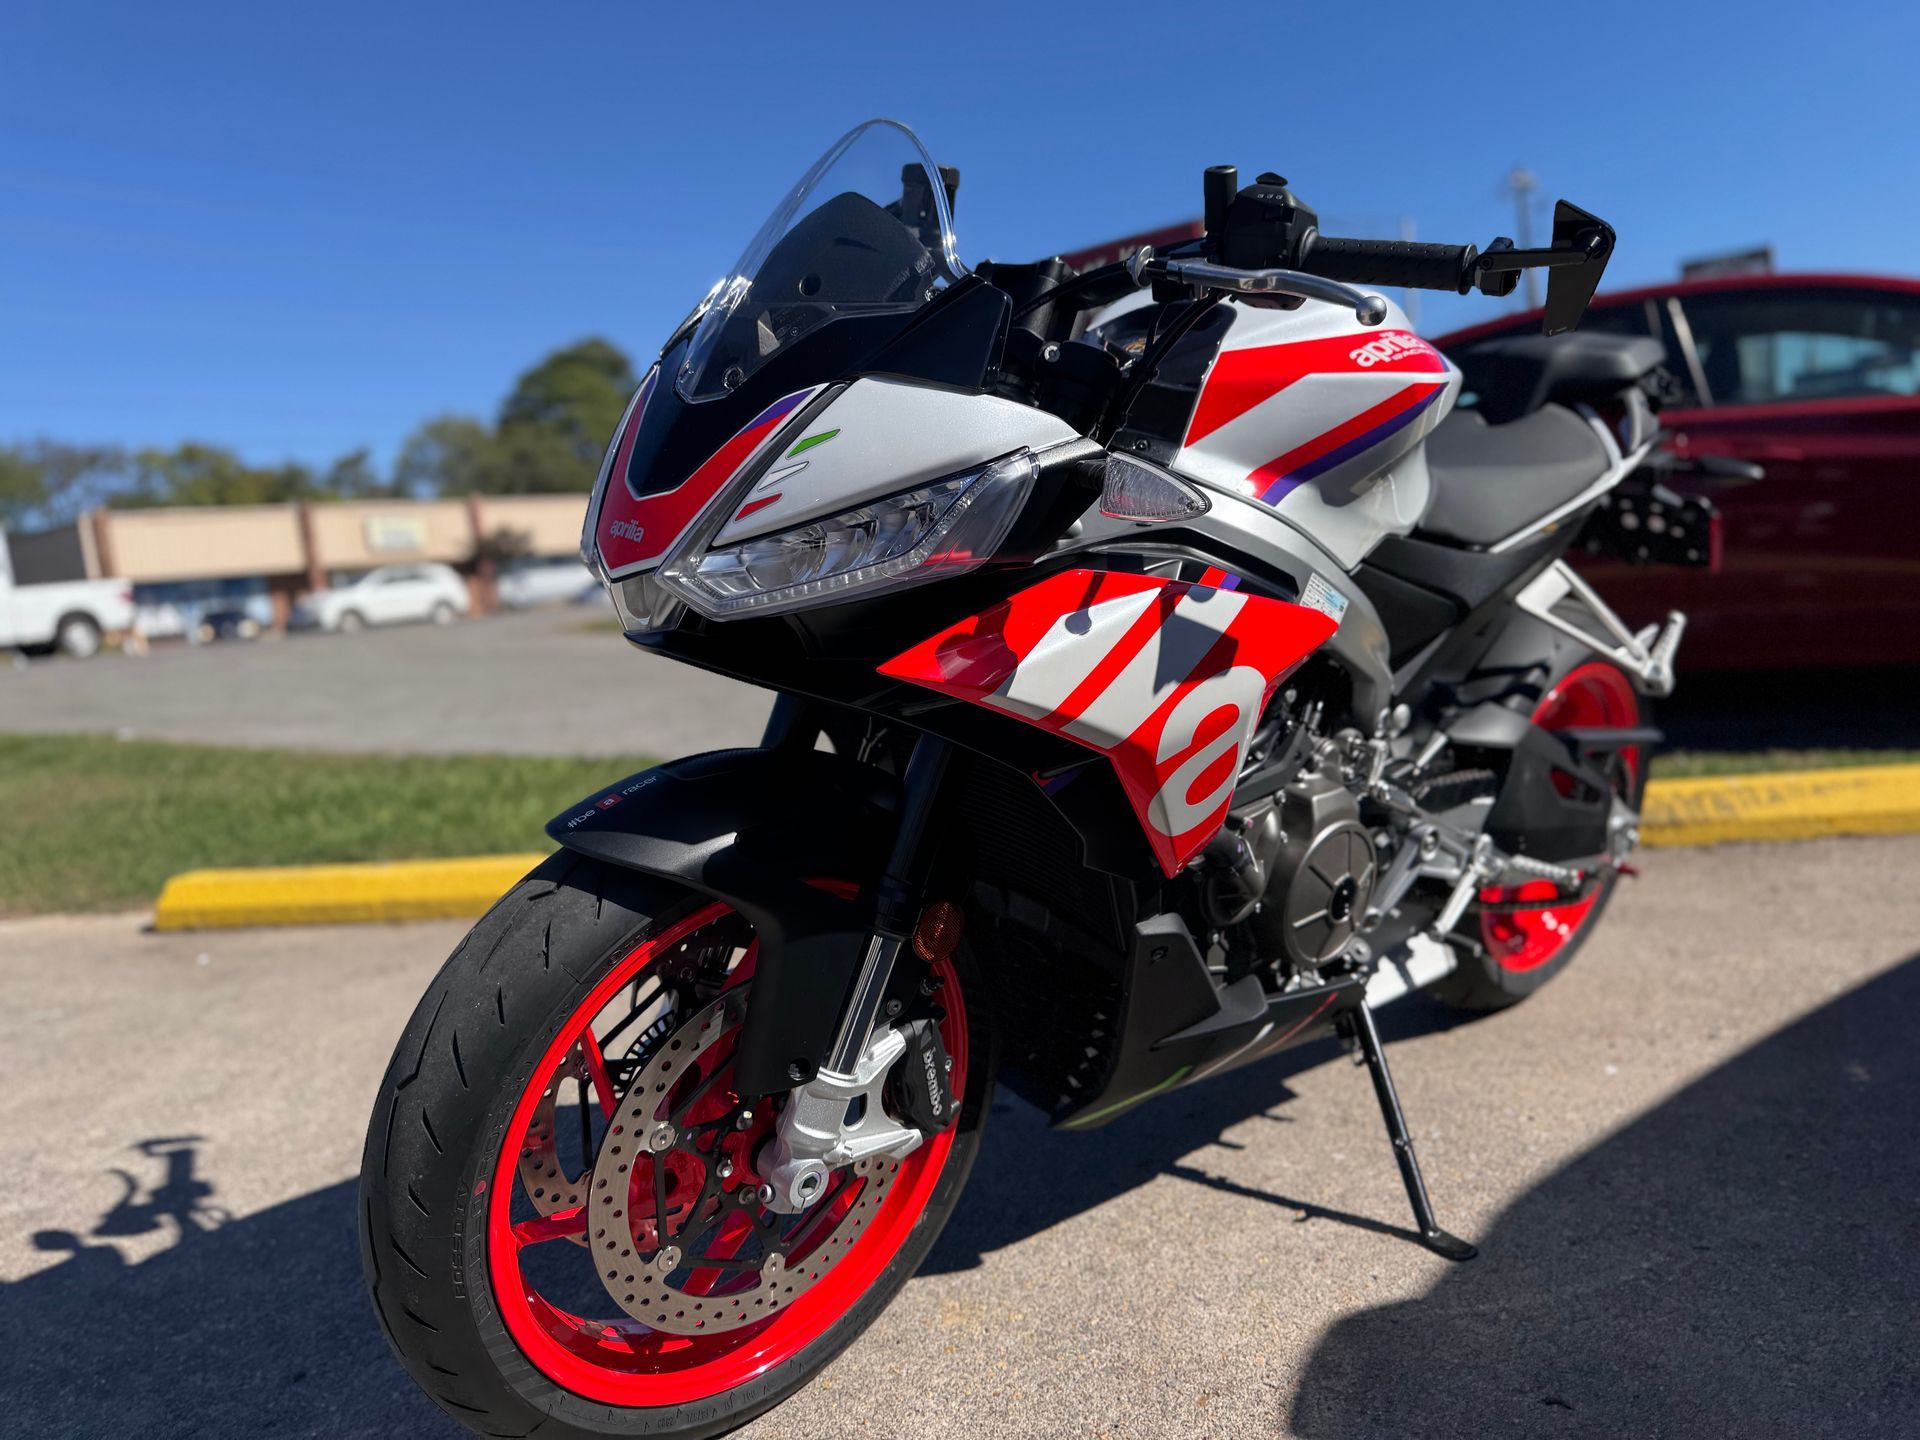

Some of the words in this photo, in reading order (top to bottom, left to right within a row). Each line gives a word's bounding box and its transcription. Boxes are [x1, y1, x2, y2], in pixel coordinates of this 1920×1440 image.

[1348, 331, 1426, 367] aprilia
[610, 519, 645, 543] aprilia
[567, 808, 596, 828] #be
[602, 797, 615, 807] a
[621, 774, 657, 796] racer
[923, 1047, 943, 1116] brembo
